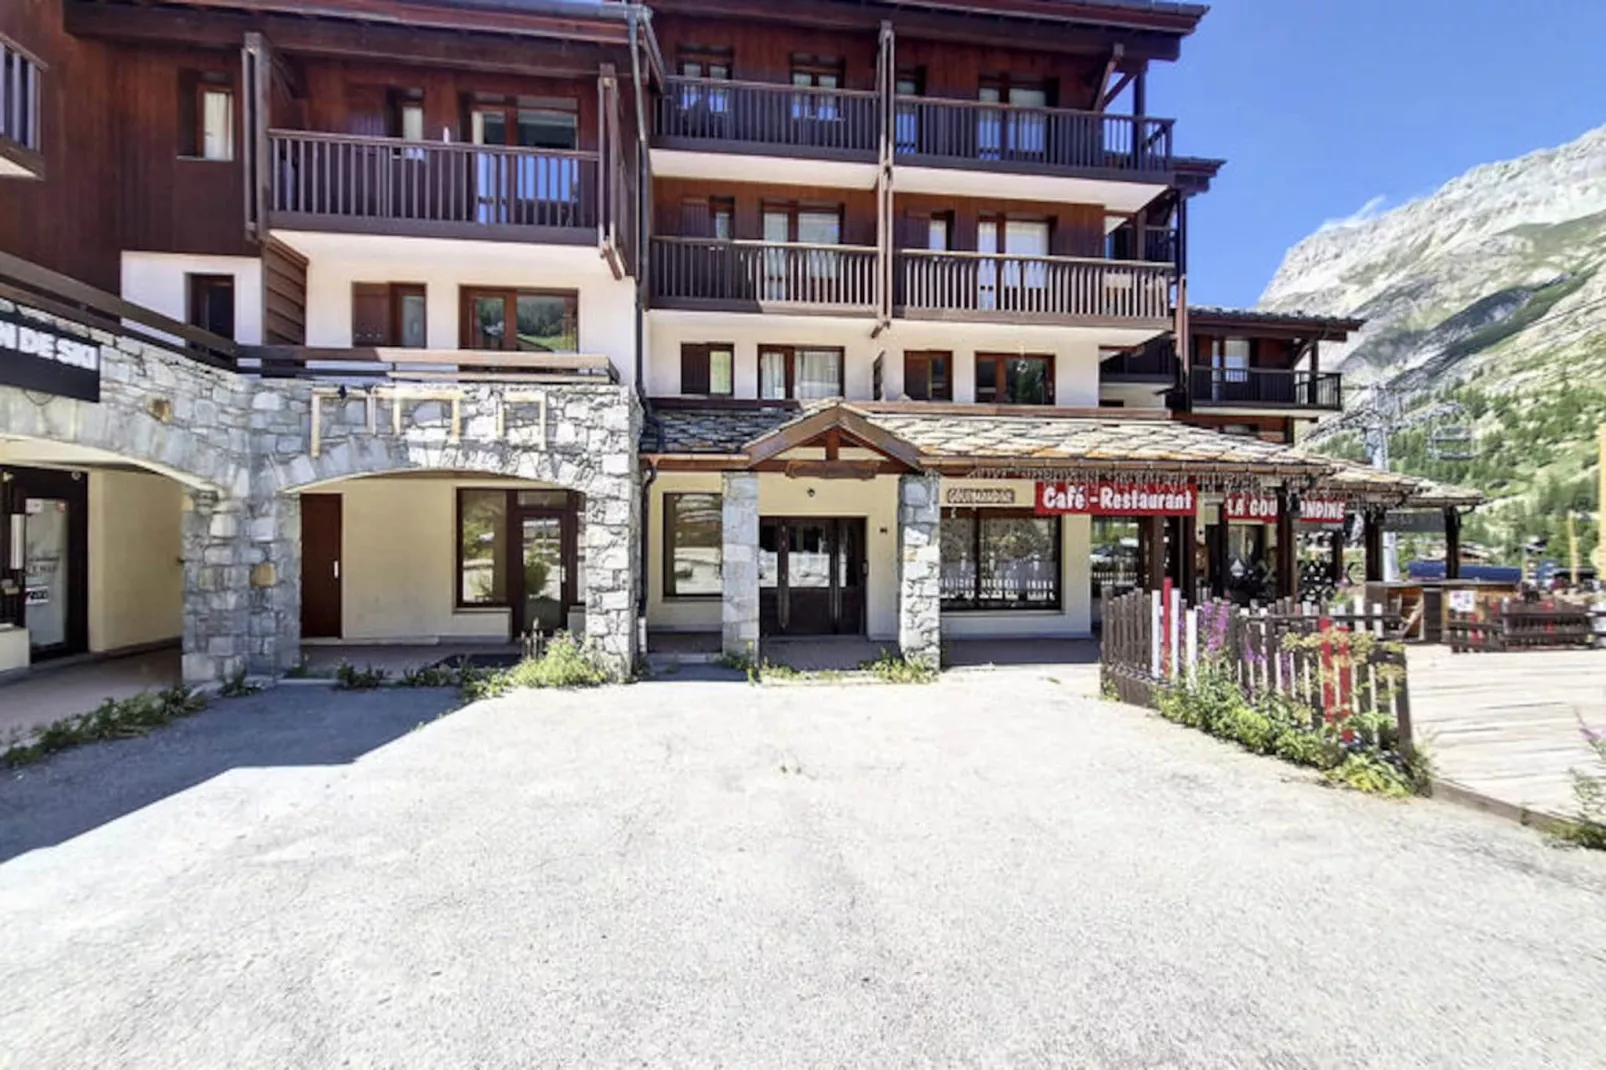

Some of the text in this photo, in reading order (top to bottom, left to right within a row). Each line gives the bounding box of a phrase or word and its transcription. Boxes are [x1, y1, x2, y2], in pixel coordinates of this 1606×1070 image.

[19, 326, 55, 360] DE
[56, 338, 98, 371] SKI
[1227, 498, 1245, 516] LA
